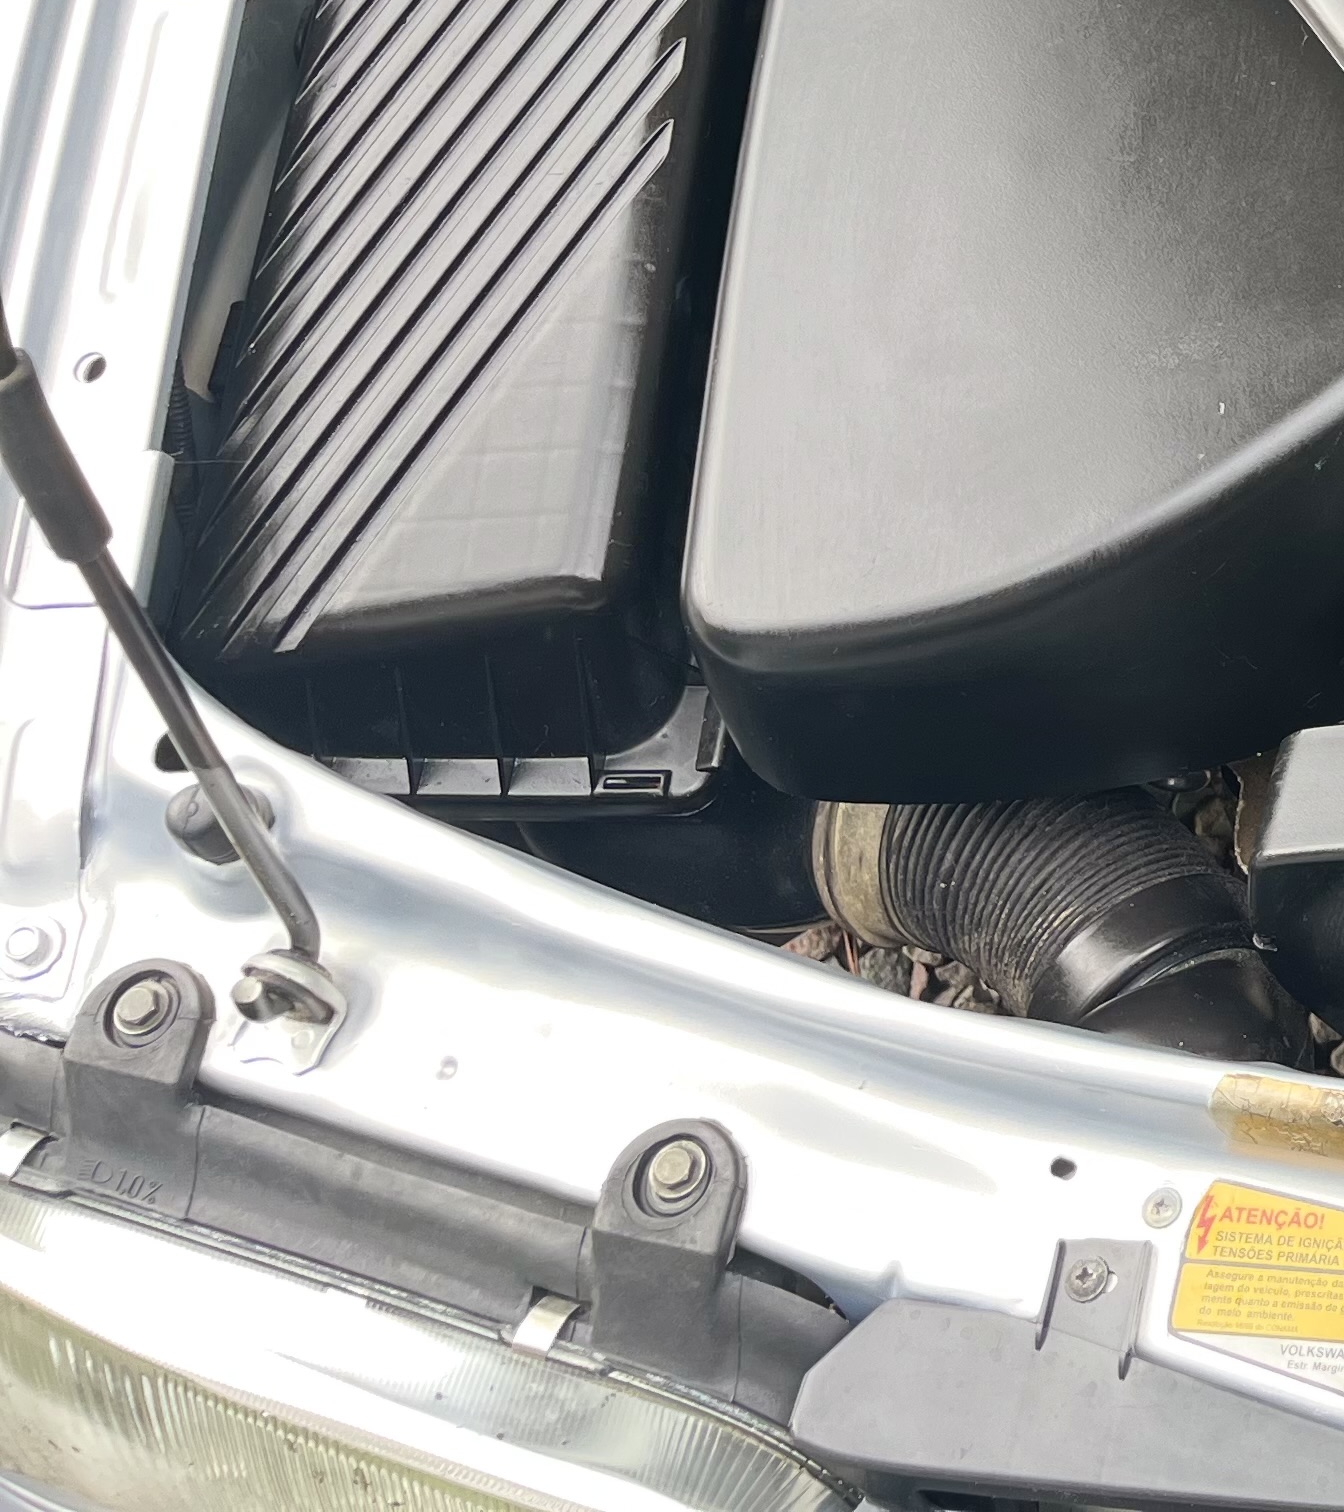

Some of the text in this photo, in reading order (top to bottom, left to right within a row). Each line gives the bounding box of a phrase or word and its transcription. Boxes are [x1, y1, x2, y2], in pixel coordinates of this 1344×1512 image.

[1218, 1206, 1325, 1231] ATENÇÃO!
[1215, 1231, 1273, 1246] SISTEMA
[1277, 1236, 1294, 1247] DE
[1212, 1246, 1273, 1261] TENSÕES
[1277, 1250, 1339, 1266] PRIMÁRIA
[1267, 1276, 1328, 1287] manutenção
